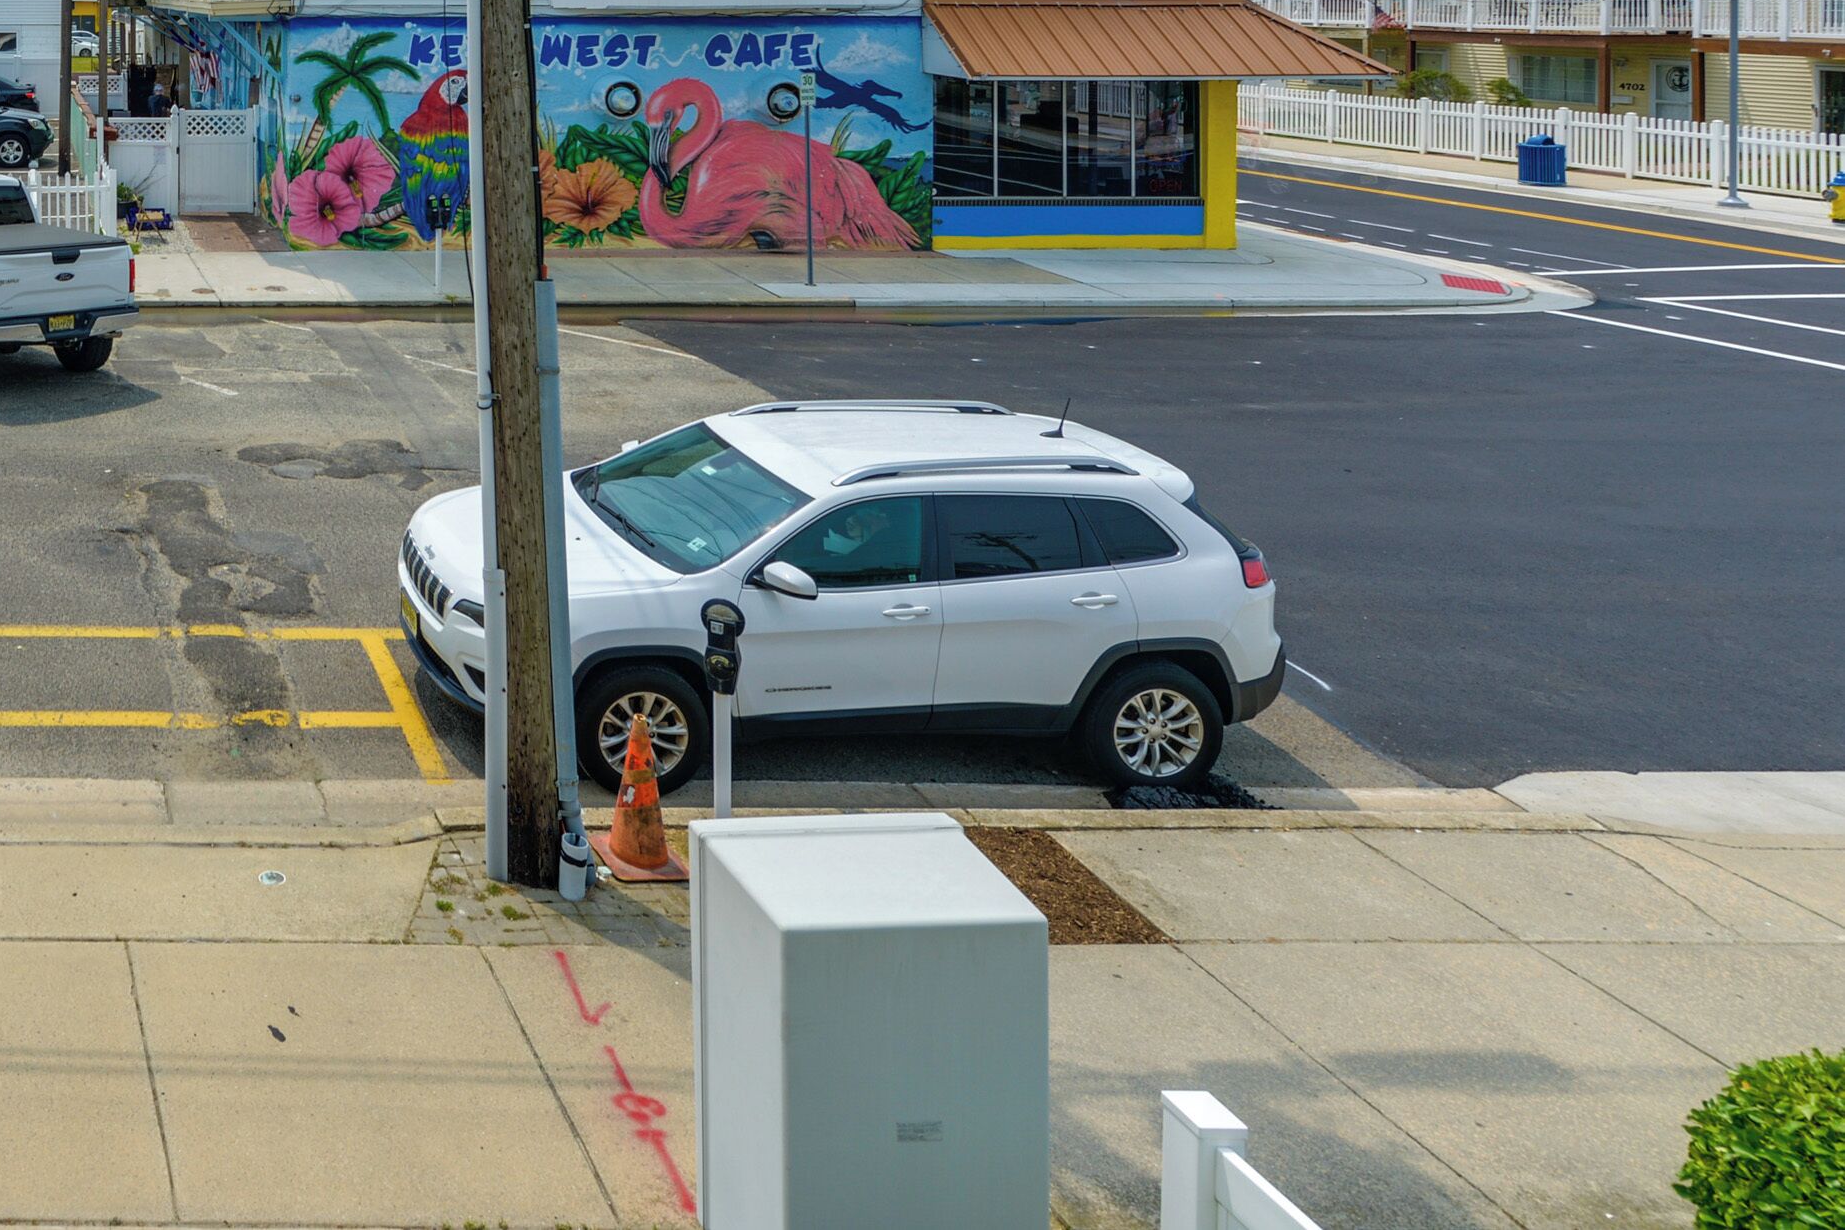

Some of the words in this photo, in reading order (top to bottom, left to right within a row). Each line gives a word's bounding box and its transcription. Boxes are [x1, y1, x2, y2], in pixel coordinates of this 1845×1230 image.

[408, 33, 465, 68] KE
[539, 33, 658, 68] WEST
[704, 31, 815, 68] CAFE
[802, 74, 814, 87] 30
[1619, 82, 1646, 91] 4702
